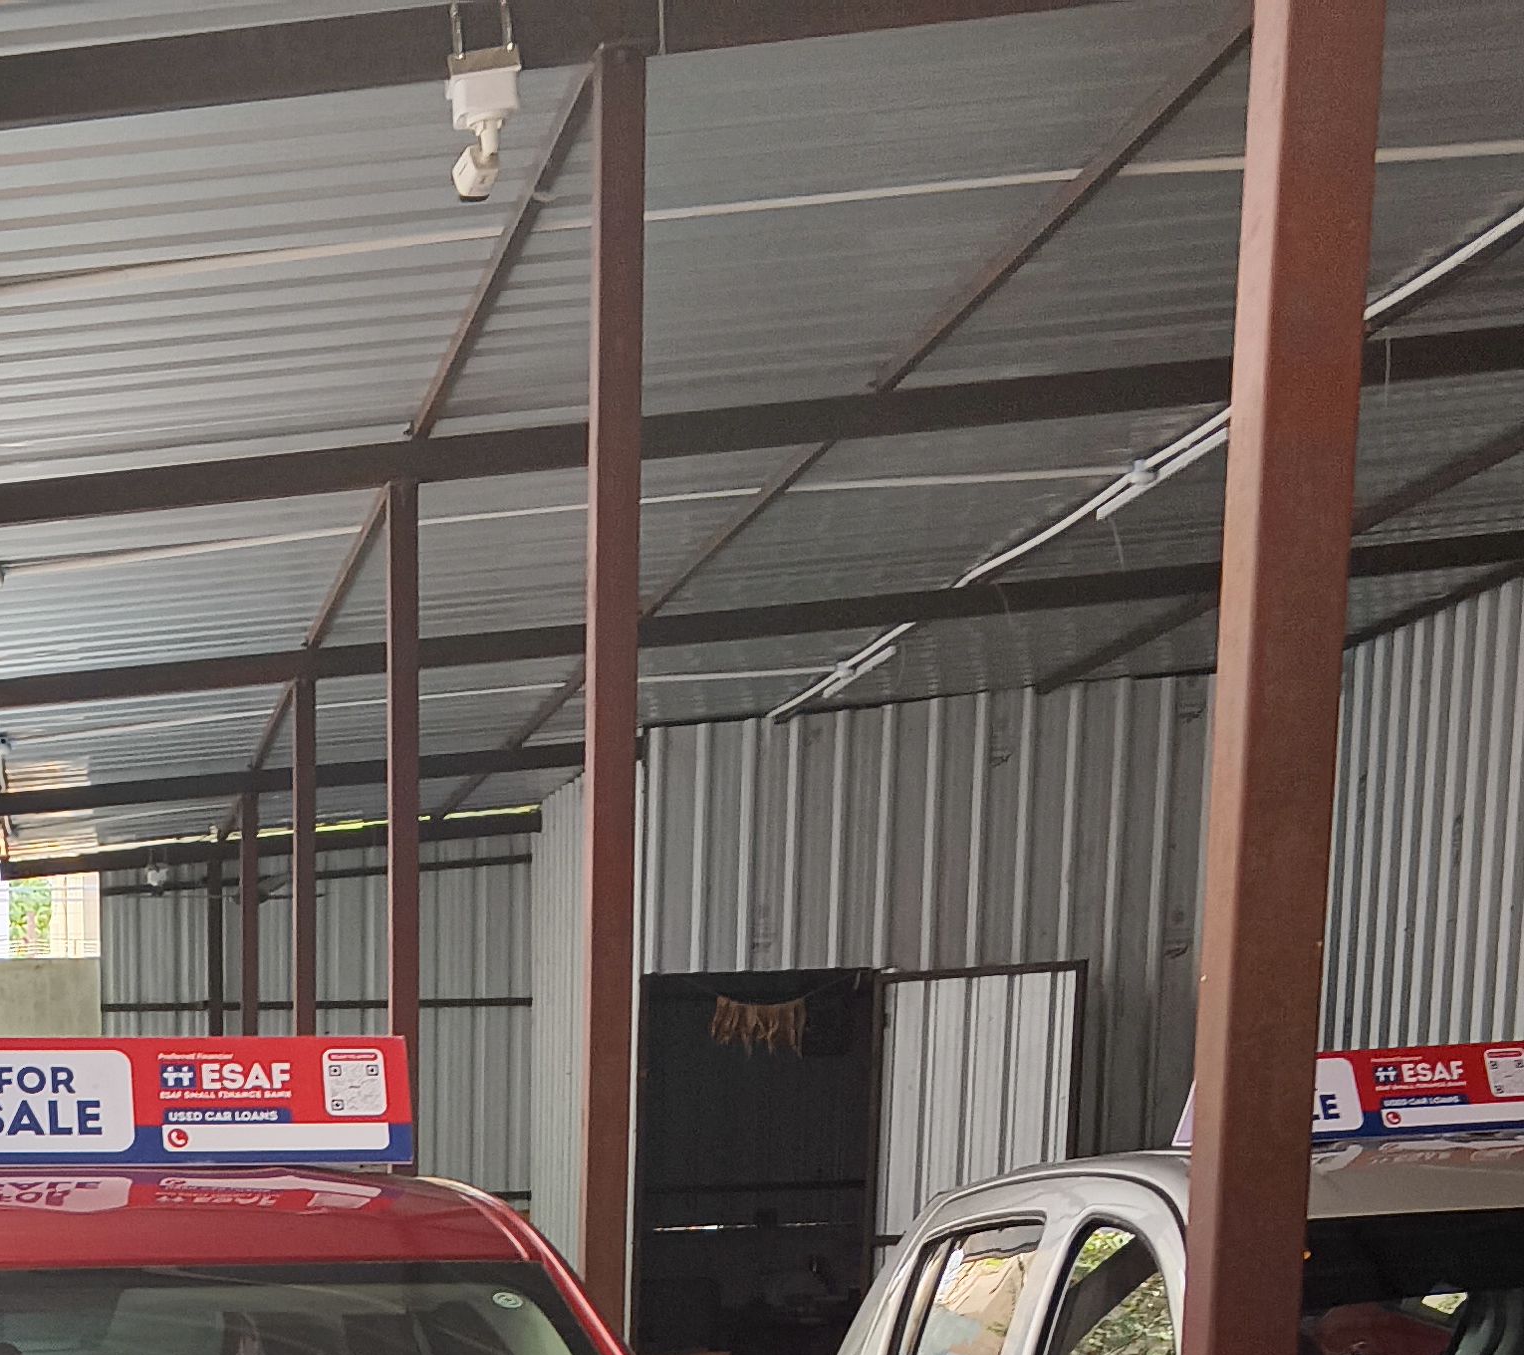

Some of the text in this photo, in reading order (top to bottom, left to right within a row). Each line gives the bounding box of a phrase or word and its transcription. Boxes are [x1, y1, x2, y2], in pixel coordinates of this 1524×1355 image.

[201, 1062, 291, 1089] ESAF
[1401, 1060, 1464, 1083] ESAF
[168, 1110, 279, 1122] USED CAR LOANS
